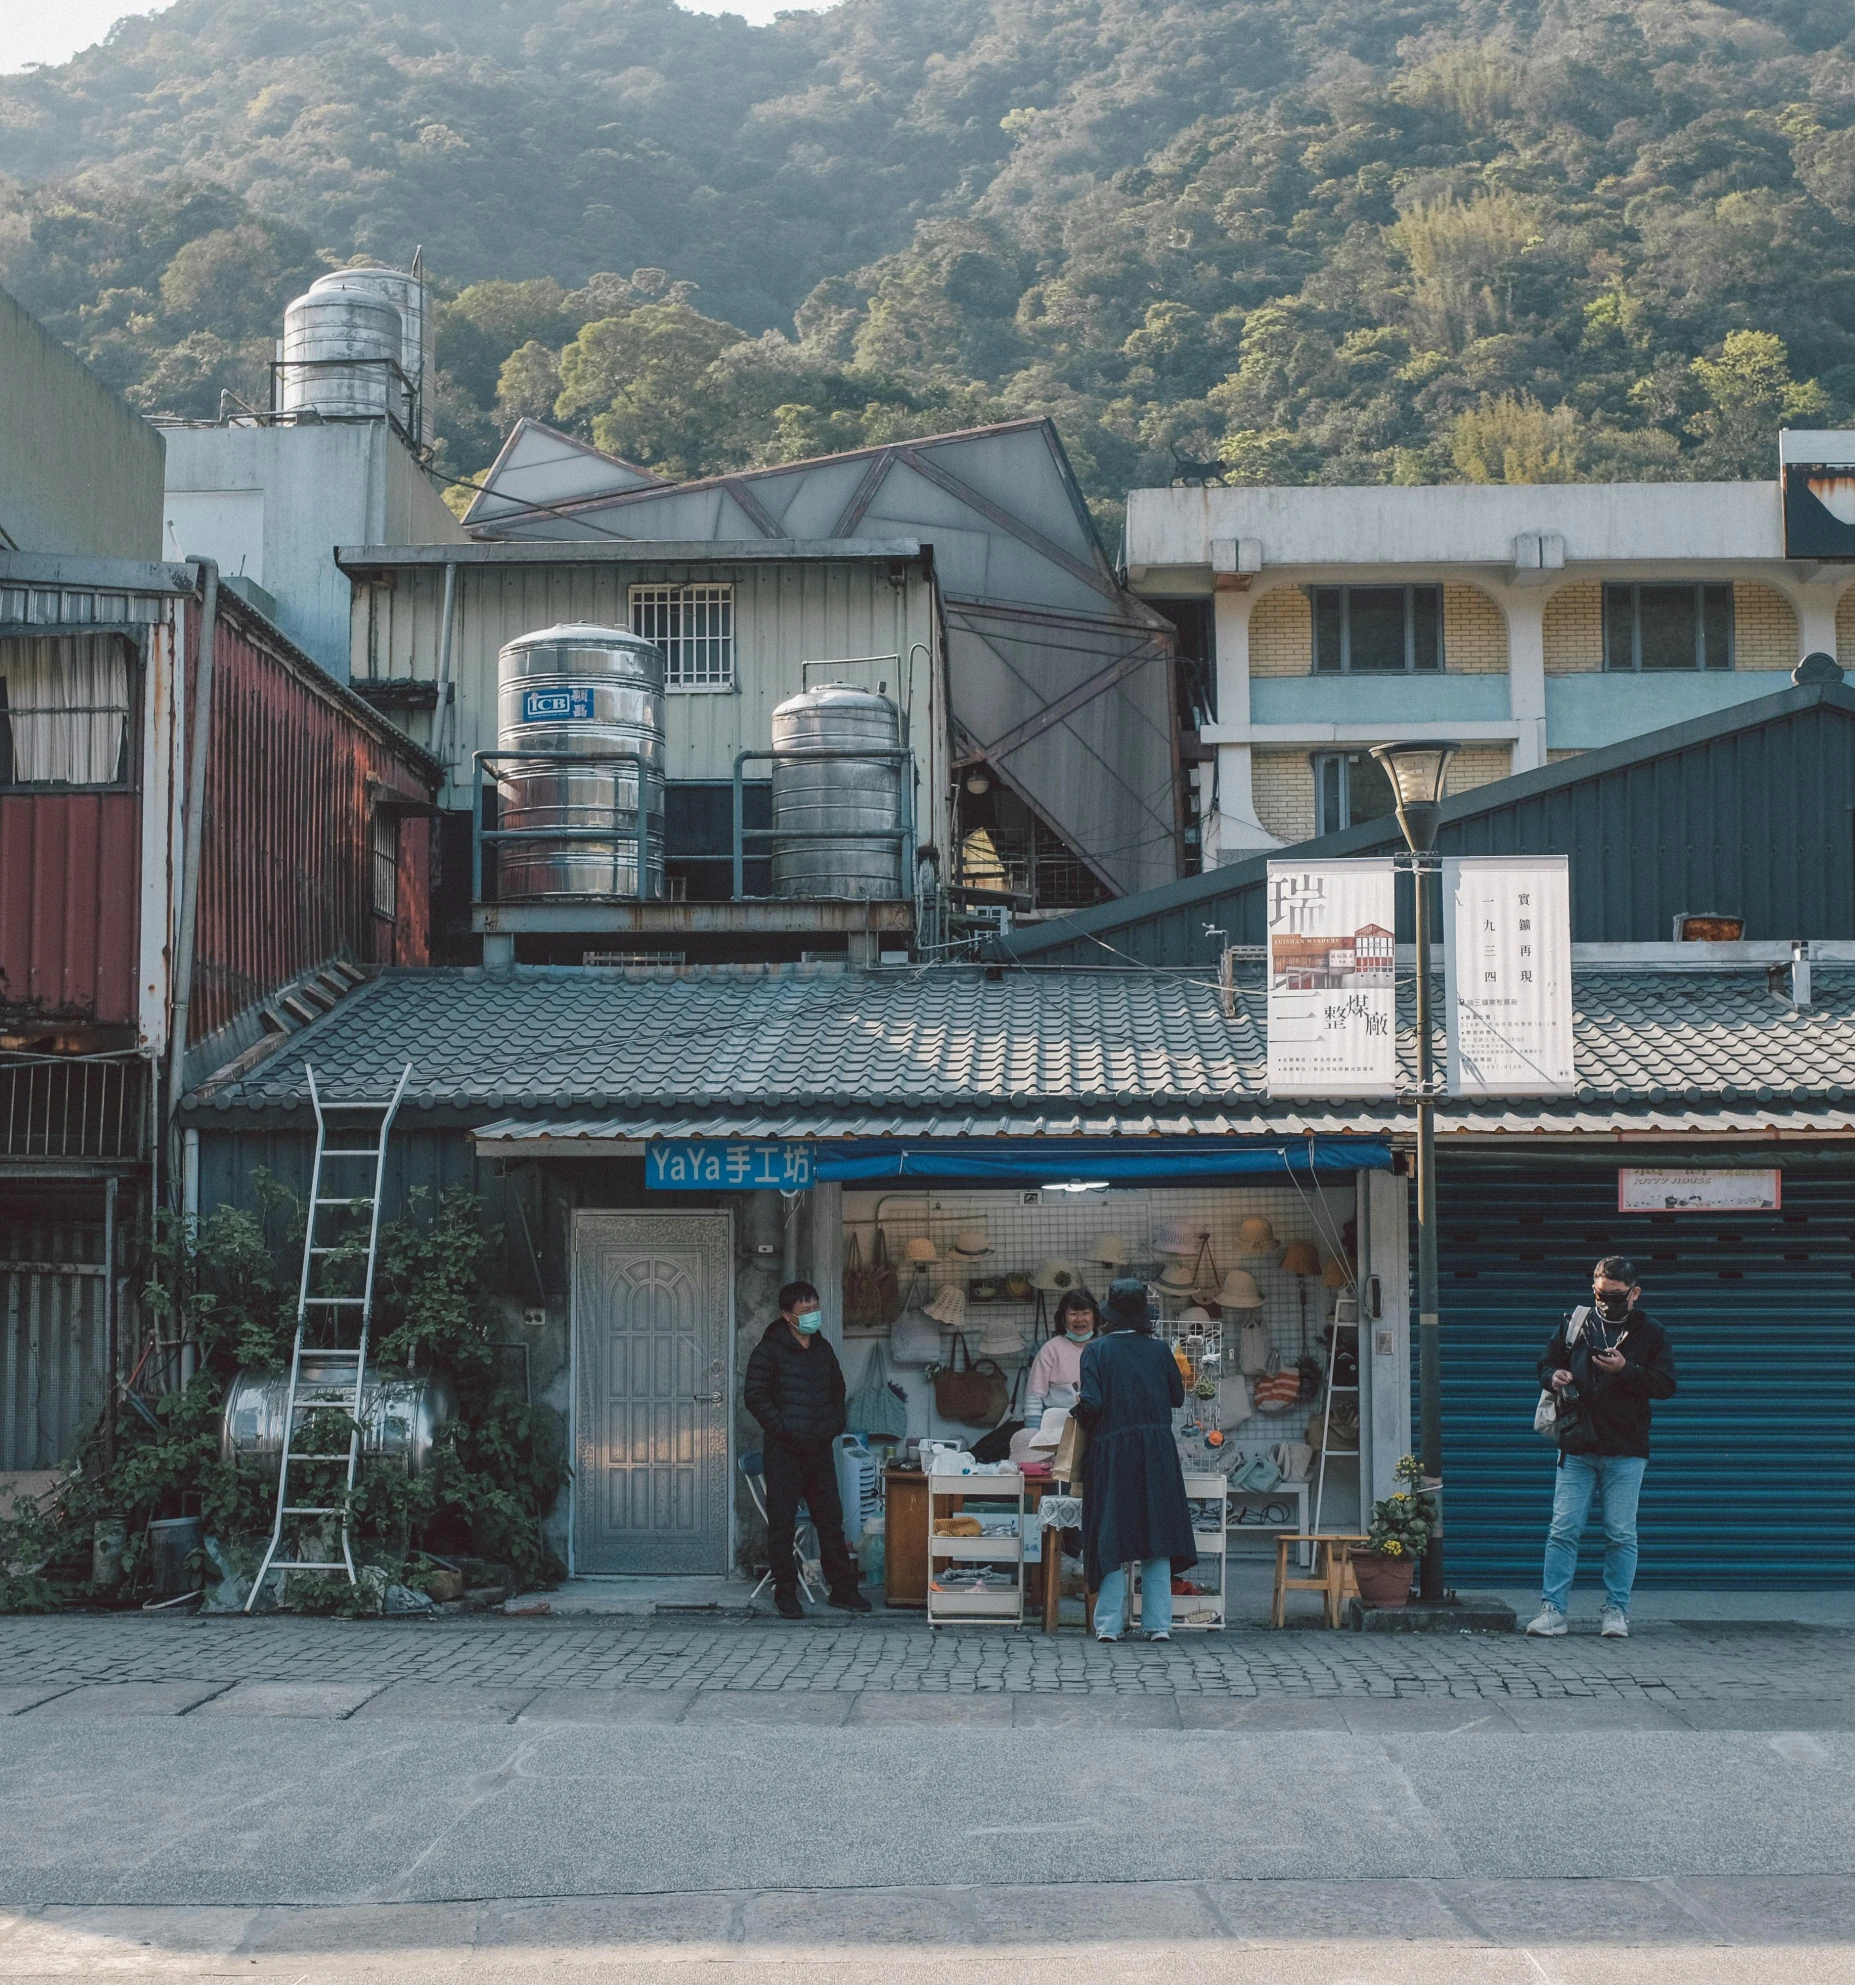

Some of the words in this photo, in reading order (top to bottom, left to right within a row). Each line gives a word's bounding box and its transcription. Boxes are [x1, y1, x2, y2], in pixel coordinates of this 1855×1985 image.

[1268, 874, 1326, 934] 瑞
[1482, 897, 1497, 983] 一九三四
[1323, 994, 1388, 1036] 整煤廠
[1131, 1270, 1157, 1279] OPEN
